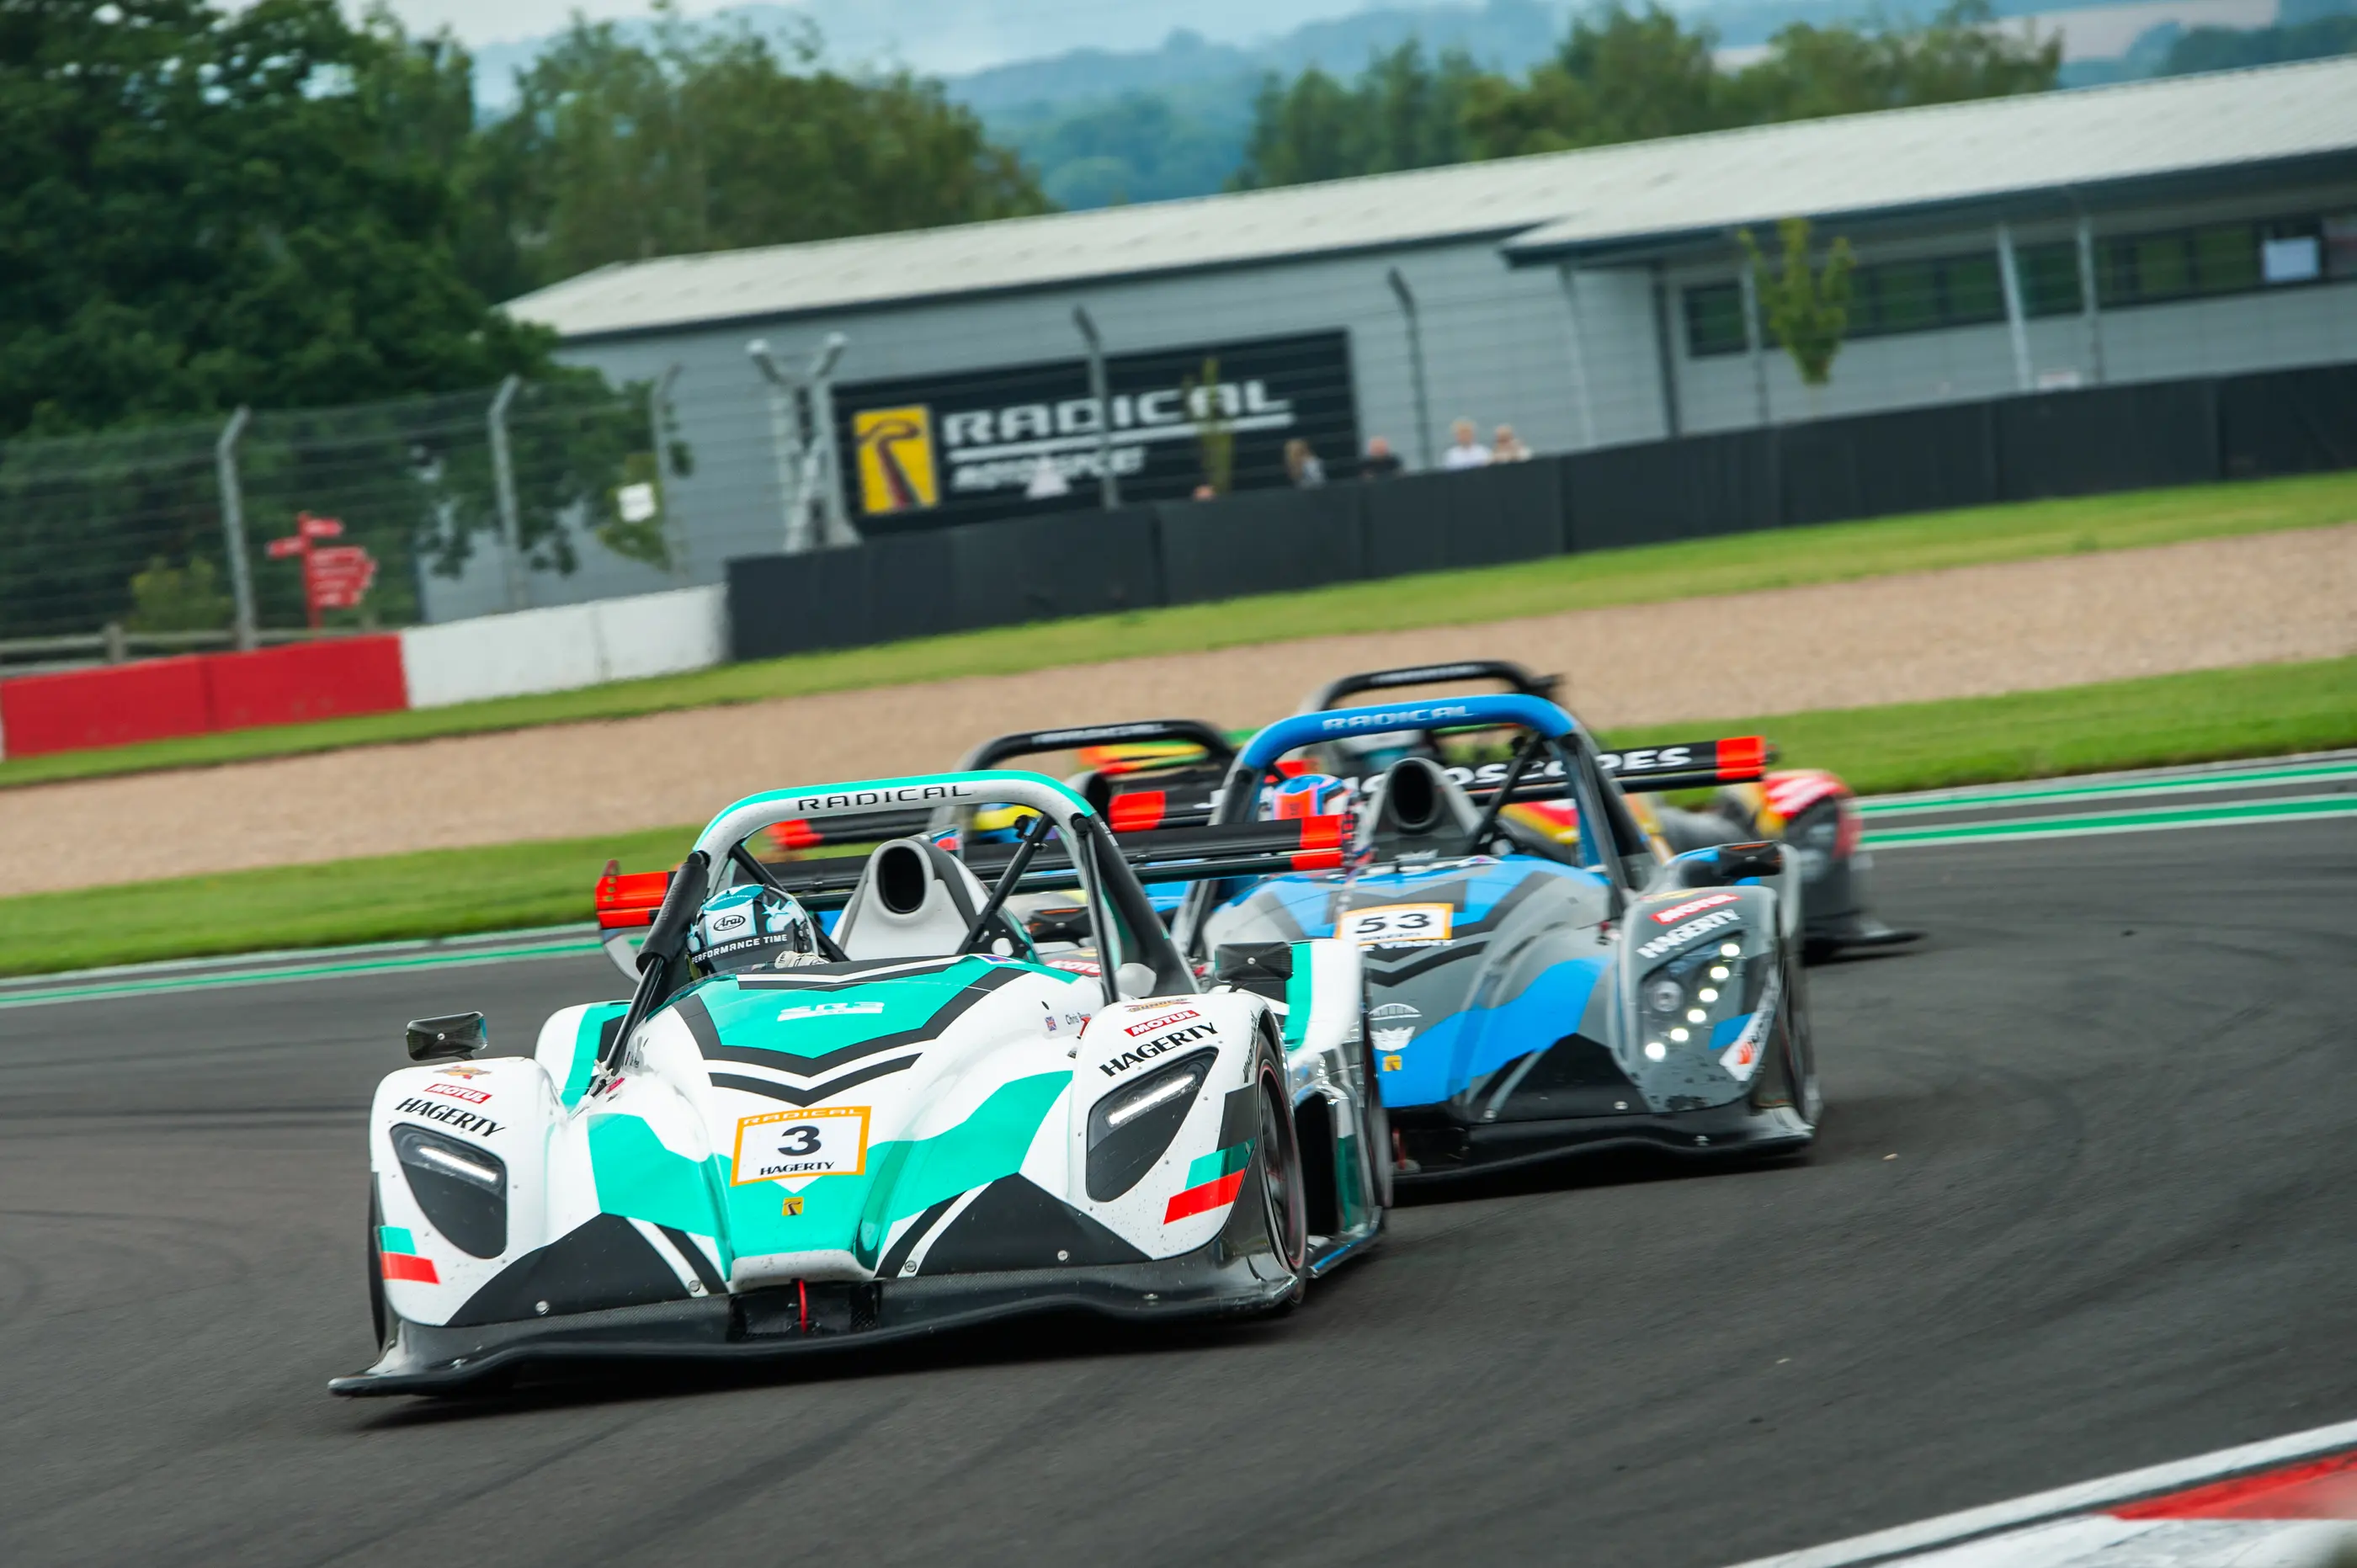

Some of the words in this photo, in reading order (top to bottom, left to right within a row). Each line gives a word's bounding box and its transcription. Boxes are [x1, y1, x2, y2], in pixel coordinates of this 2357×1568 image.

[944, 380, 1294, 446] RADICAL
[1322, 705, 1474, 731] RADICAL
[797, 785, 973, 811] RADICAL
[720, 916, 742, 928] Arai
[1354, 913, 1433, 935] 53
[691, 938, 761, 964] PERFORMANCE
[763, 933, 788, 944] TIME
[1132, 1010, 1196, 1035] MOTUL
[1099, 1022, 1219, 1077] HAGERTY
[428, 1083, 488, 1103] MOTUL
[394, 1098, 507, 1137] HAGERTY
[743, 1108, 865, 1126] RADICAL
[777, 1124, 822, 1157] 3
[759, 1161, 835, 1177] HAGERTY
